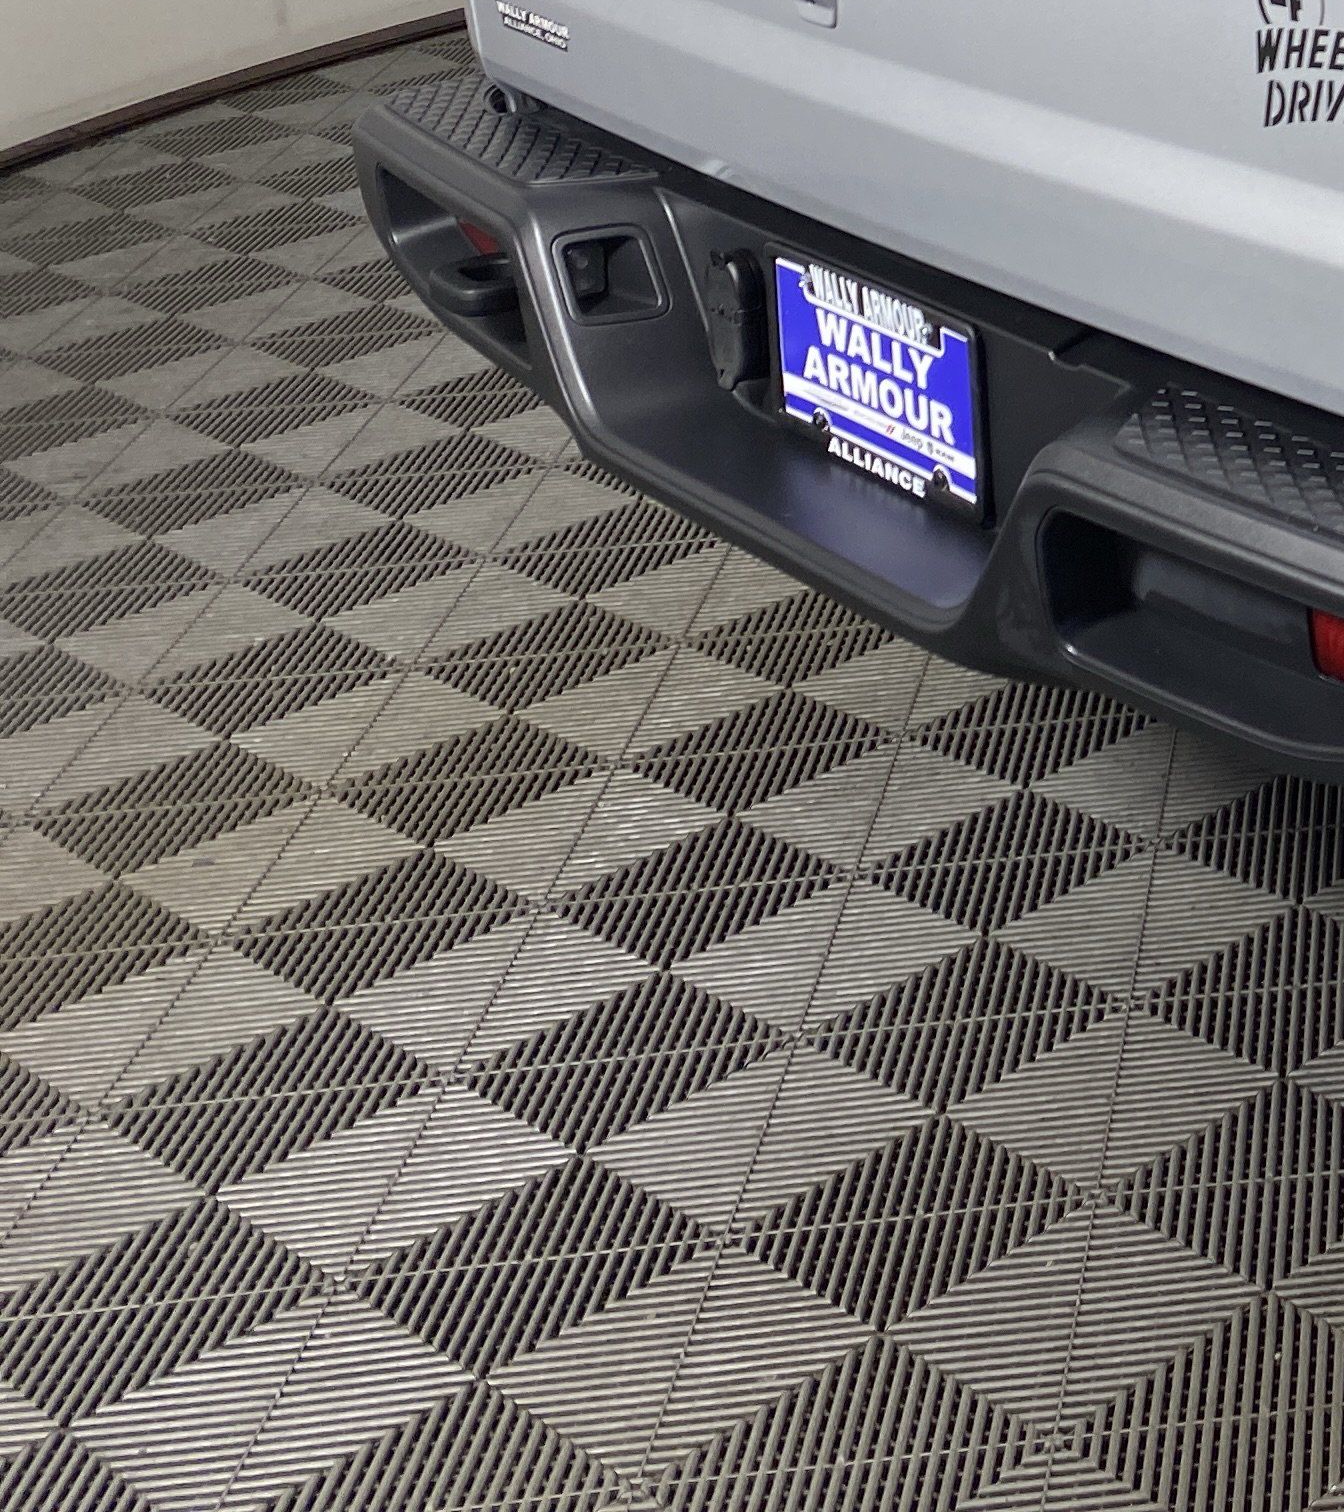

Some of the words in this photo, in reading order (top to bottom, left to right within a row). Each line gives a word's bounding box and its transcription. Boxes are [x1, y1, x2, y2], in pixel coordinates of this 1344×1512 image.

[809, 263, 861, 315] WALLY
[862, 286, 926, 340] ARMOUR
[815, 308, 936, 391] WALLY
[803, 345, 956, 448] ARMOUR
[828, 437, 926, 498] ALLIANCE
